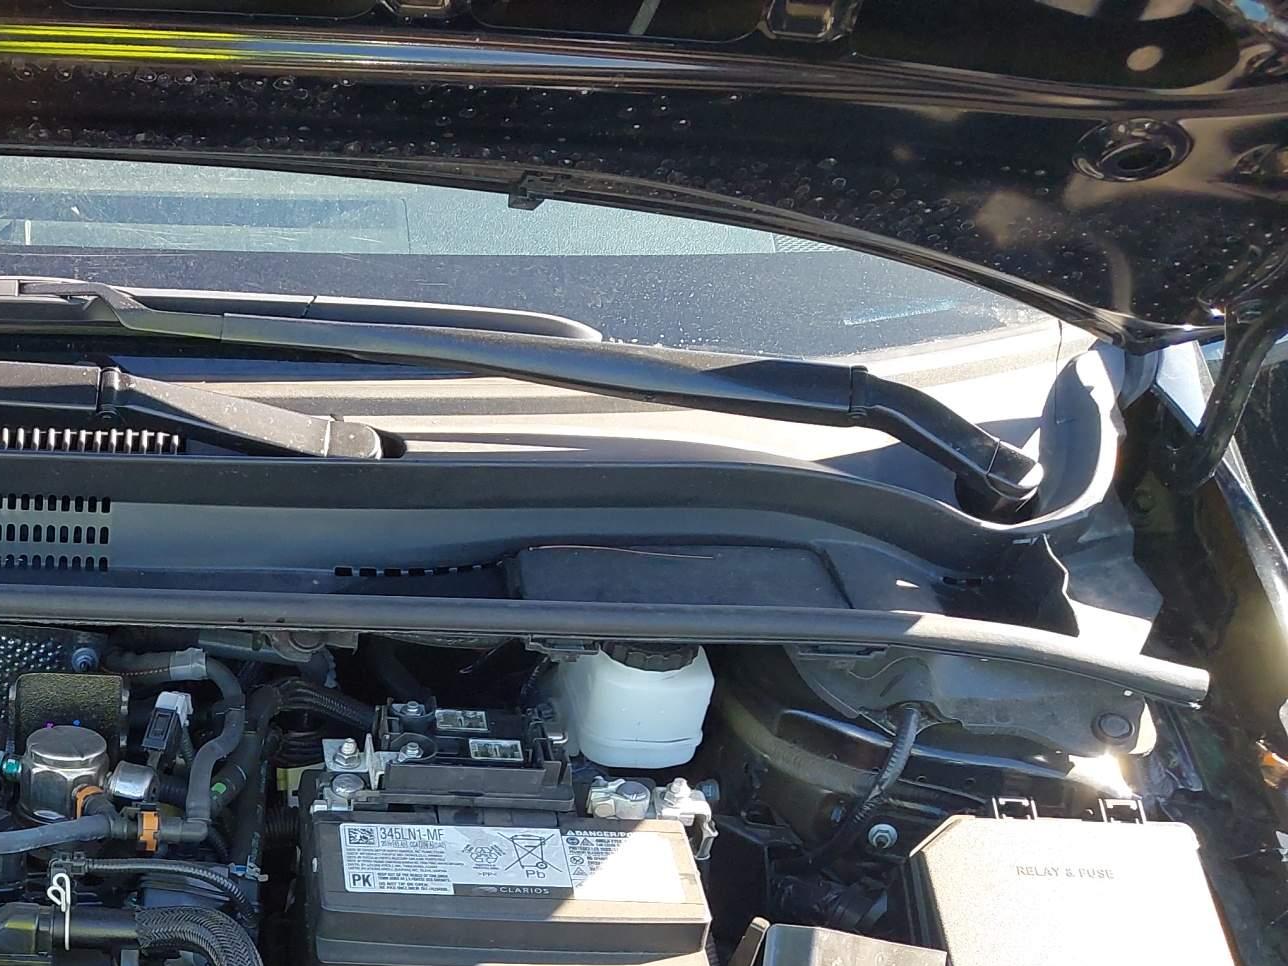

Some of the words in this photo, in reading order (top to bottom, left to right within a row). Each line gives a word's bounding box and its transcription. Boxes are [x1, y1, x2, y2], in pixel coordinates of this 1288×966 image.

[380, 827, 444, 841] 345LN1-MF
[575, 830, 633, 838] DANGER/PO
[526, 869, 546, 879] Pb
[1016, 865, 1059, 877] RELAY
[1078, 867, 1114, 880] FUSE
[352, 873, 372, 887] PK
[499, 886, 550, 895] CLARIOS
